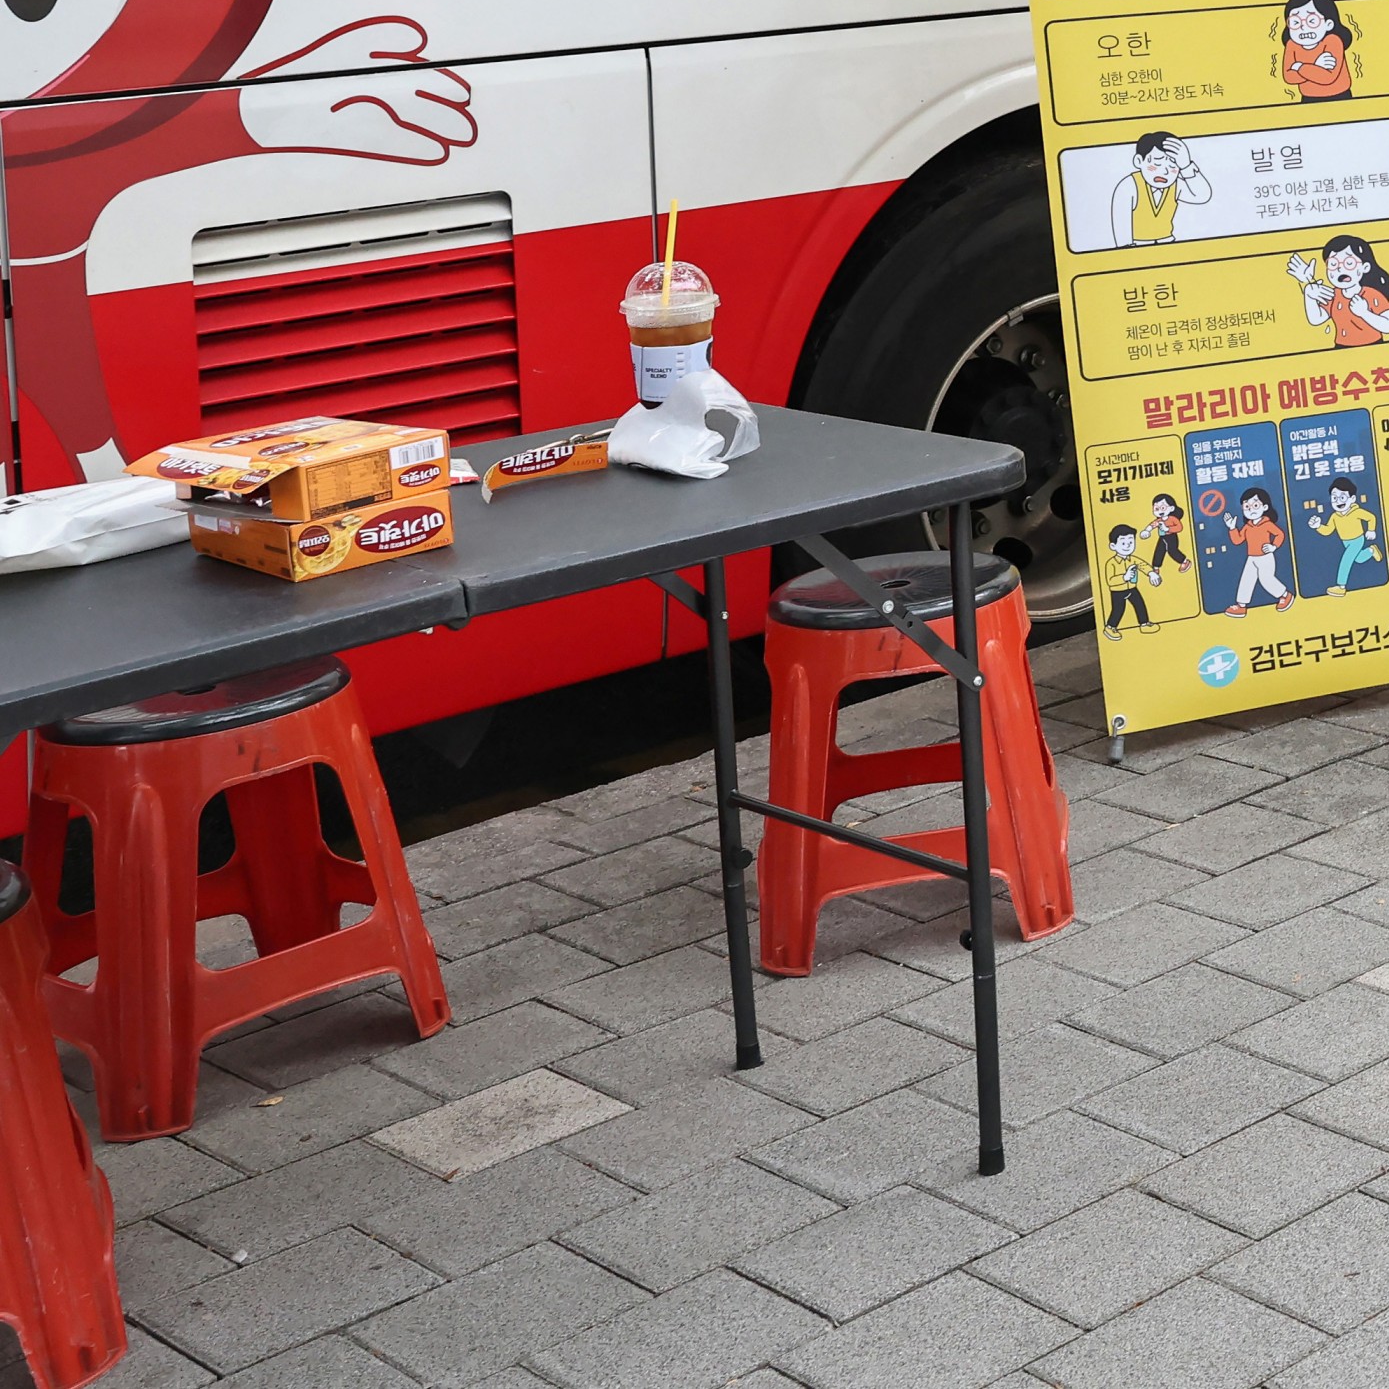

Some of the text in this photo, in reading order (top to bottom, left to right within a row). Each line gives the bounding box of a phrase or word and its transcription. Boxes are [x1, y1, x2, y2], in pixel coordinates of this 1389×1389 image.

[1097, 30, 1152, 59] 오한
[1098, 68, 1163, 87] 심한 오한이
[1173, 85, 1198, 101] 정도
[1201, 83, 1224, 98] 지속
[1250, 143, 1305, 173] 발열
[1285, 179, 1309, 196] 이상
[1312, 178, 1339, 194] 고열,
[1342, 175, 1365, 191] 심한
[1256, 195, 1359, 219] 구토가 수 시간 지속
[1123, 282, 1179, 313] 발한
[1126, 311, 1276, 341] 체온이 급격히 정상화되면서
[1128, 331, 1250, 362] 땀이 난 후 지치고 졸림
[1143, 383, 1270, 429] 말라리아
[1328, 426, 1337, 436] 시
[1213, 437, 1241, 450] 후부터
[1095, 451, 1140, 467] 3시간마다
[1214, 449, 1242, 462] 전까지
[1333, 455, 1365, 473] 착용
[398, 467, 441, 484] 마가렛트
[1097, 460, 1174, 485] 모기기피제
[1196, 460, 1264, 485] 활동 자제
[1099, 486, 1131, 504] 사용
[358, 511, 444, 546] 마가렛트
